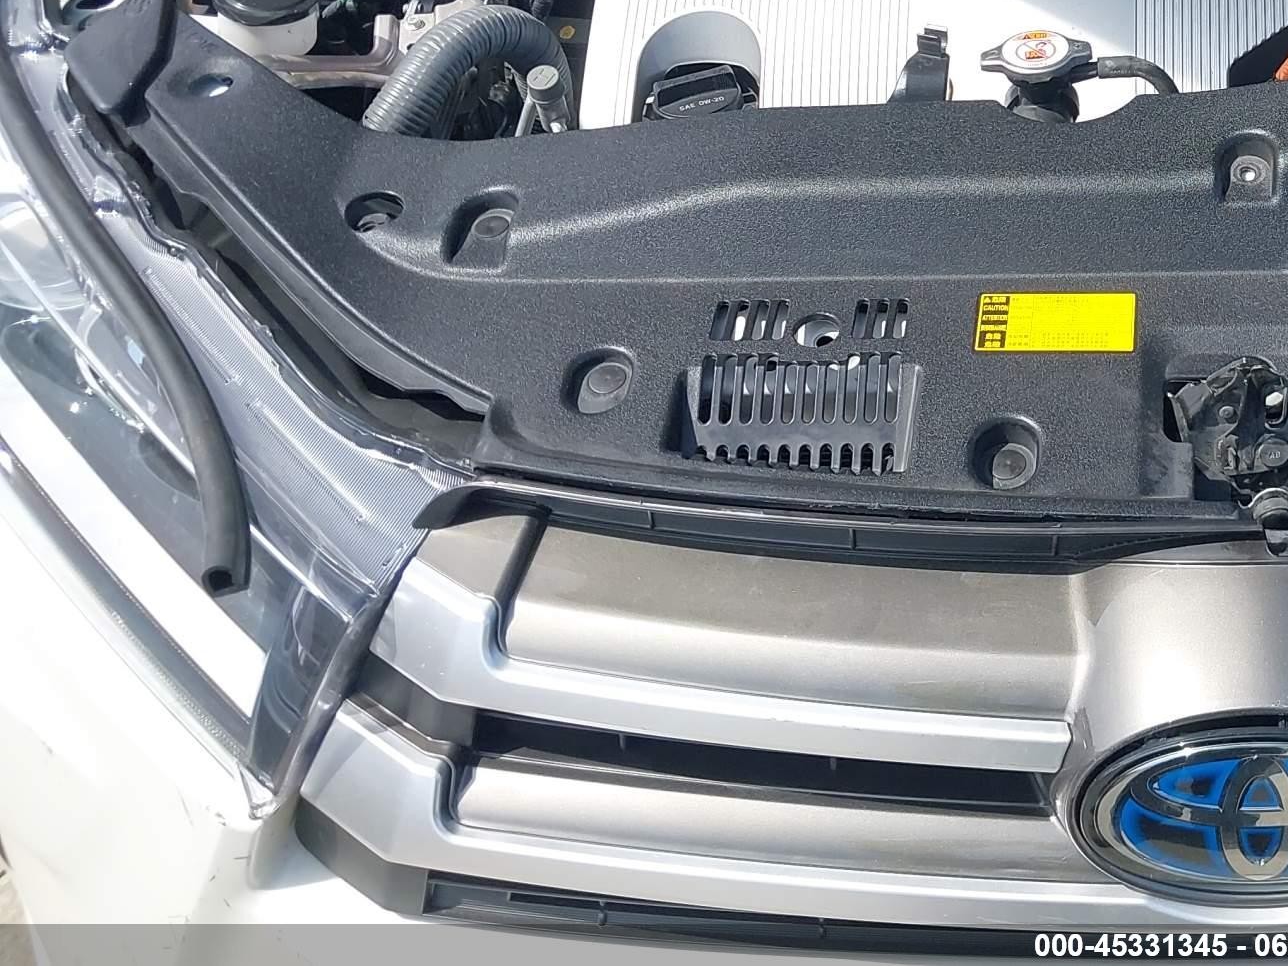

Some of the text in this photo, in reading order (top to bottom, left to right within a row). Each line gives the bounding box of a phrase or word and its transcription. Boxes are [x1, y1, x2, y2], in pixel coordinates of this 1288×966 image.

[679, 96, 725, 112] SAE 0W-20
[983, 304, 1009, 312] CAUTION
